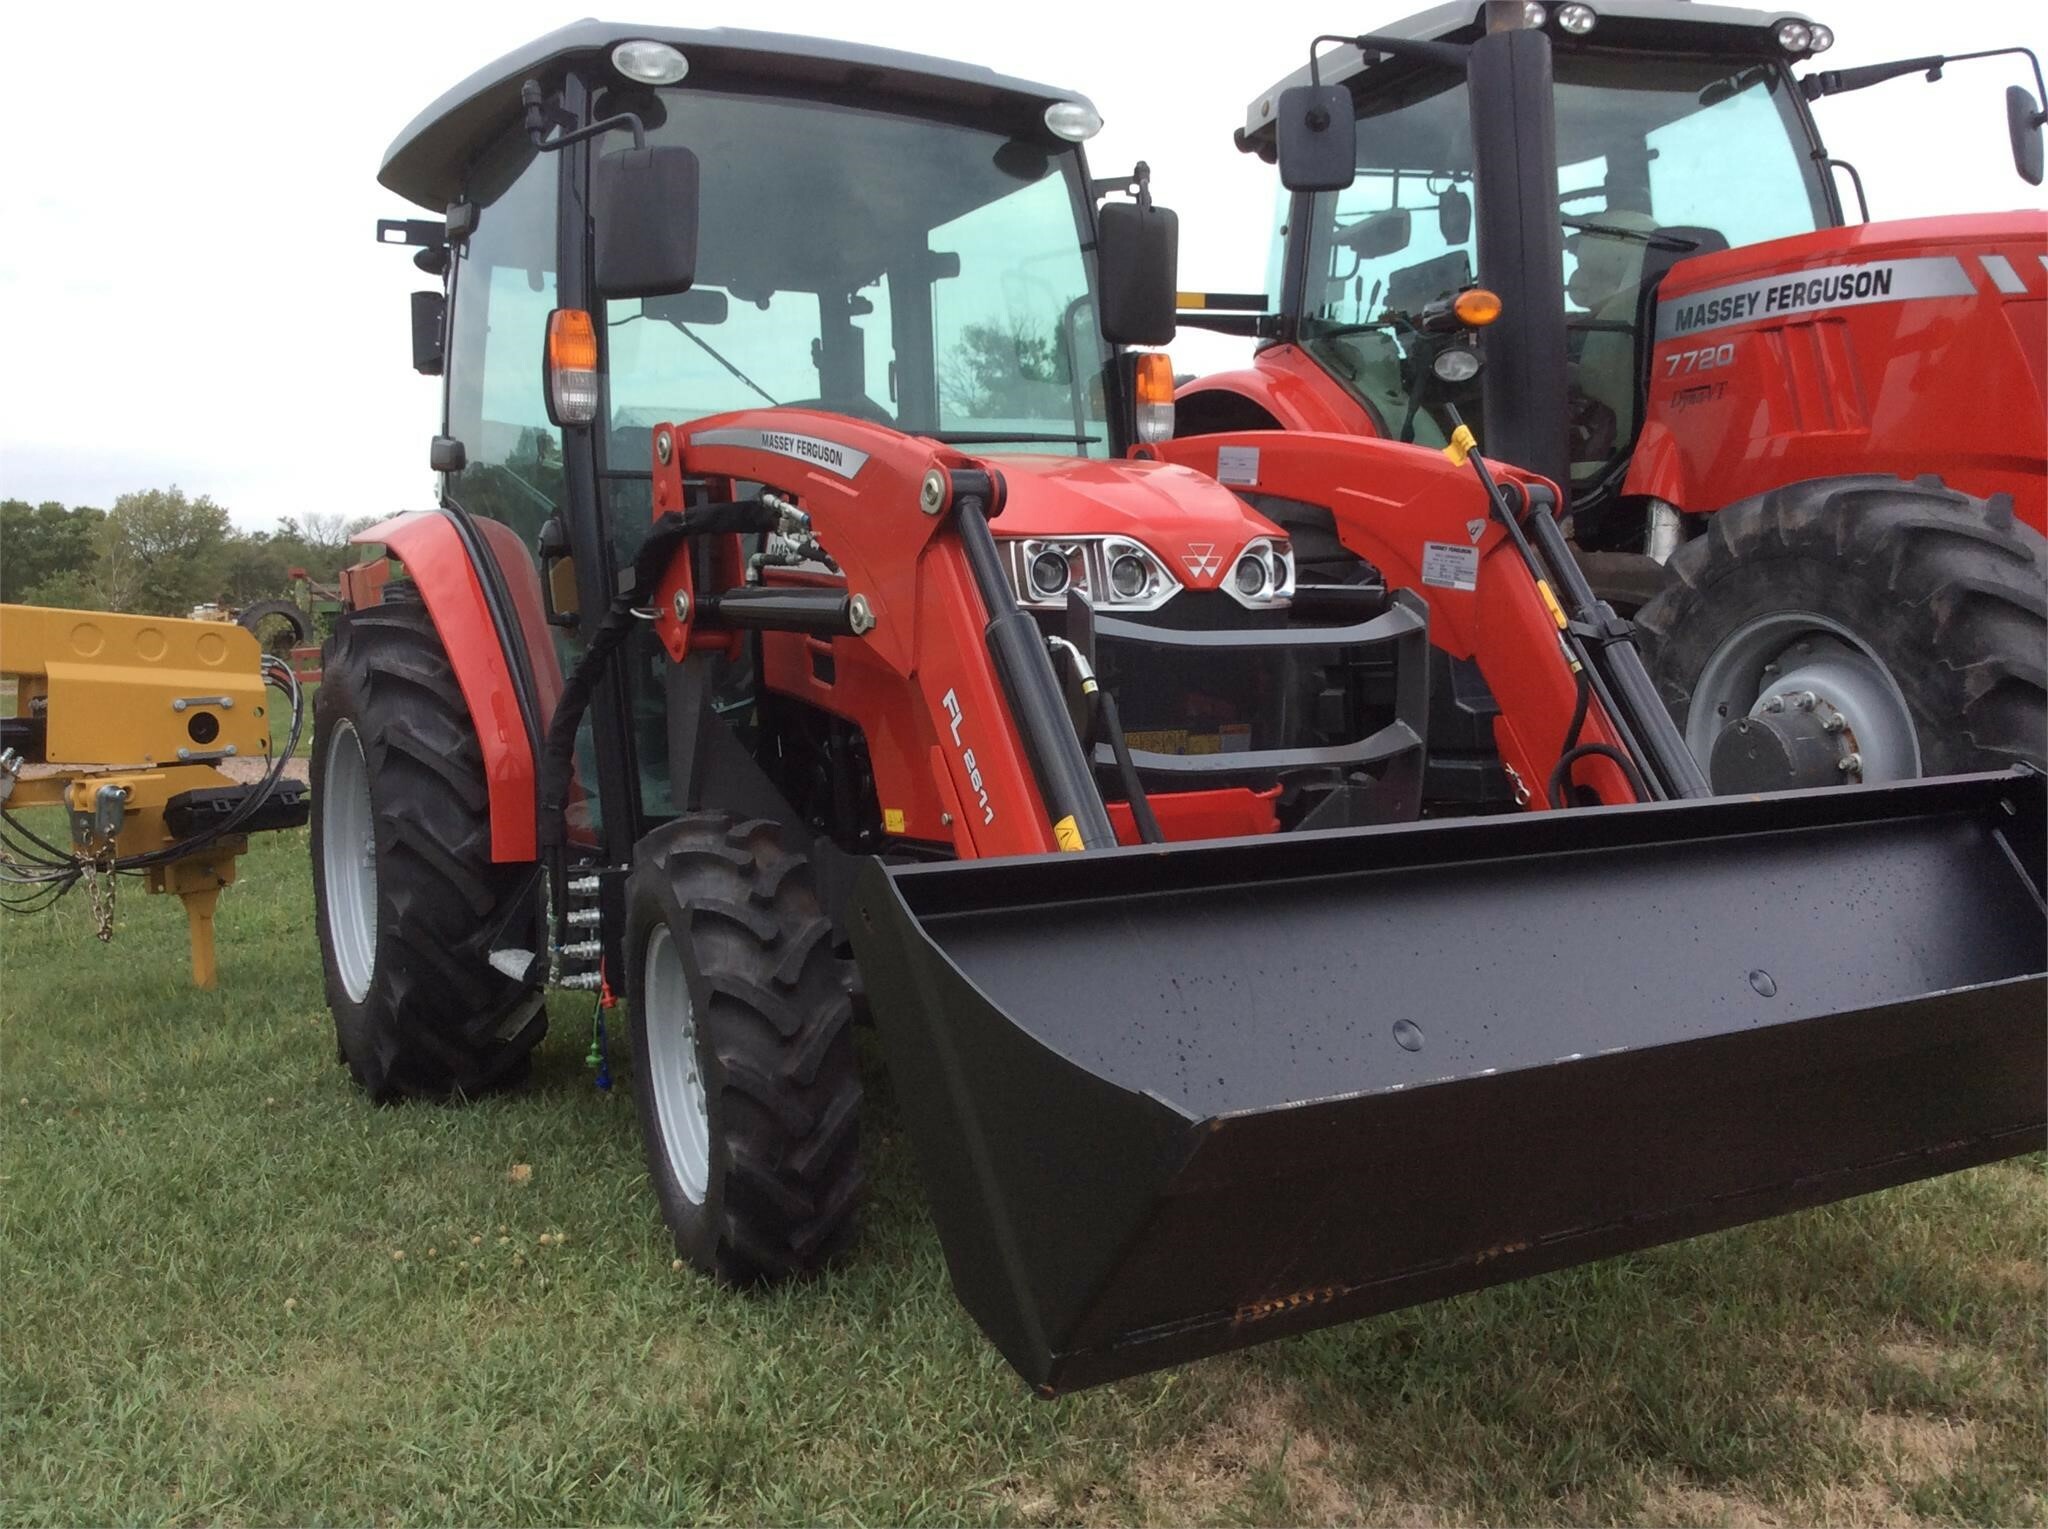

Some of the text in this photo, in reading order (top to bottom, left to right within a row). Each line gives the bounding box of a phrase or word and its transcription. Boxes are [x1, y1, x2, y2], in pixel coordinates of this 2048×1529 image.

[1674, 268, 1893, 332] MASSEY FERGUSON
[1665, 343, 1735, 376] 7720
[761, 433, 843, 467] MASSEY FERGUSON
[942, 687, 995, 826] FL 2611
